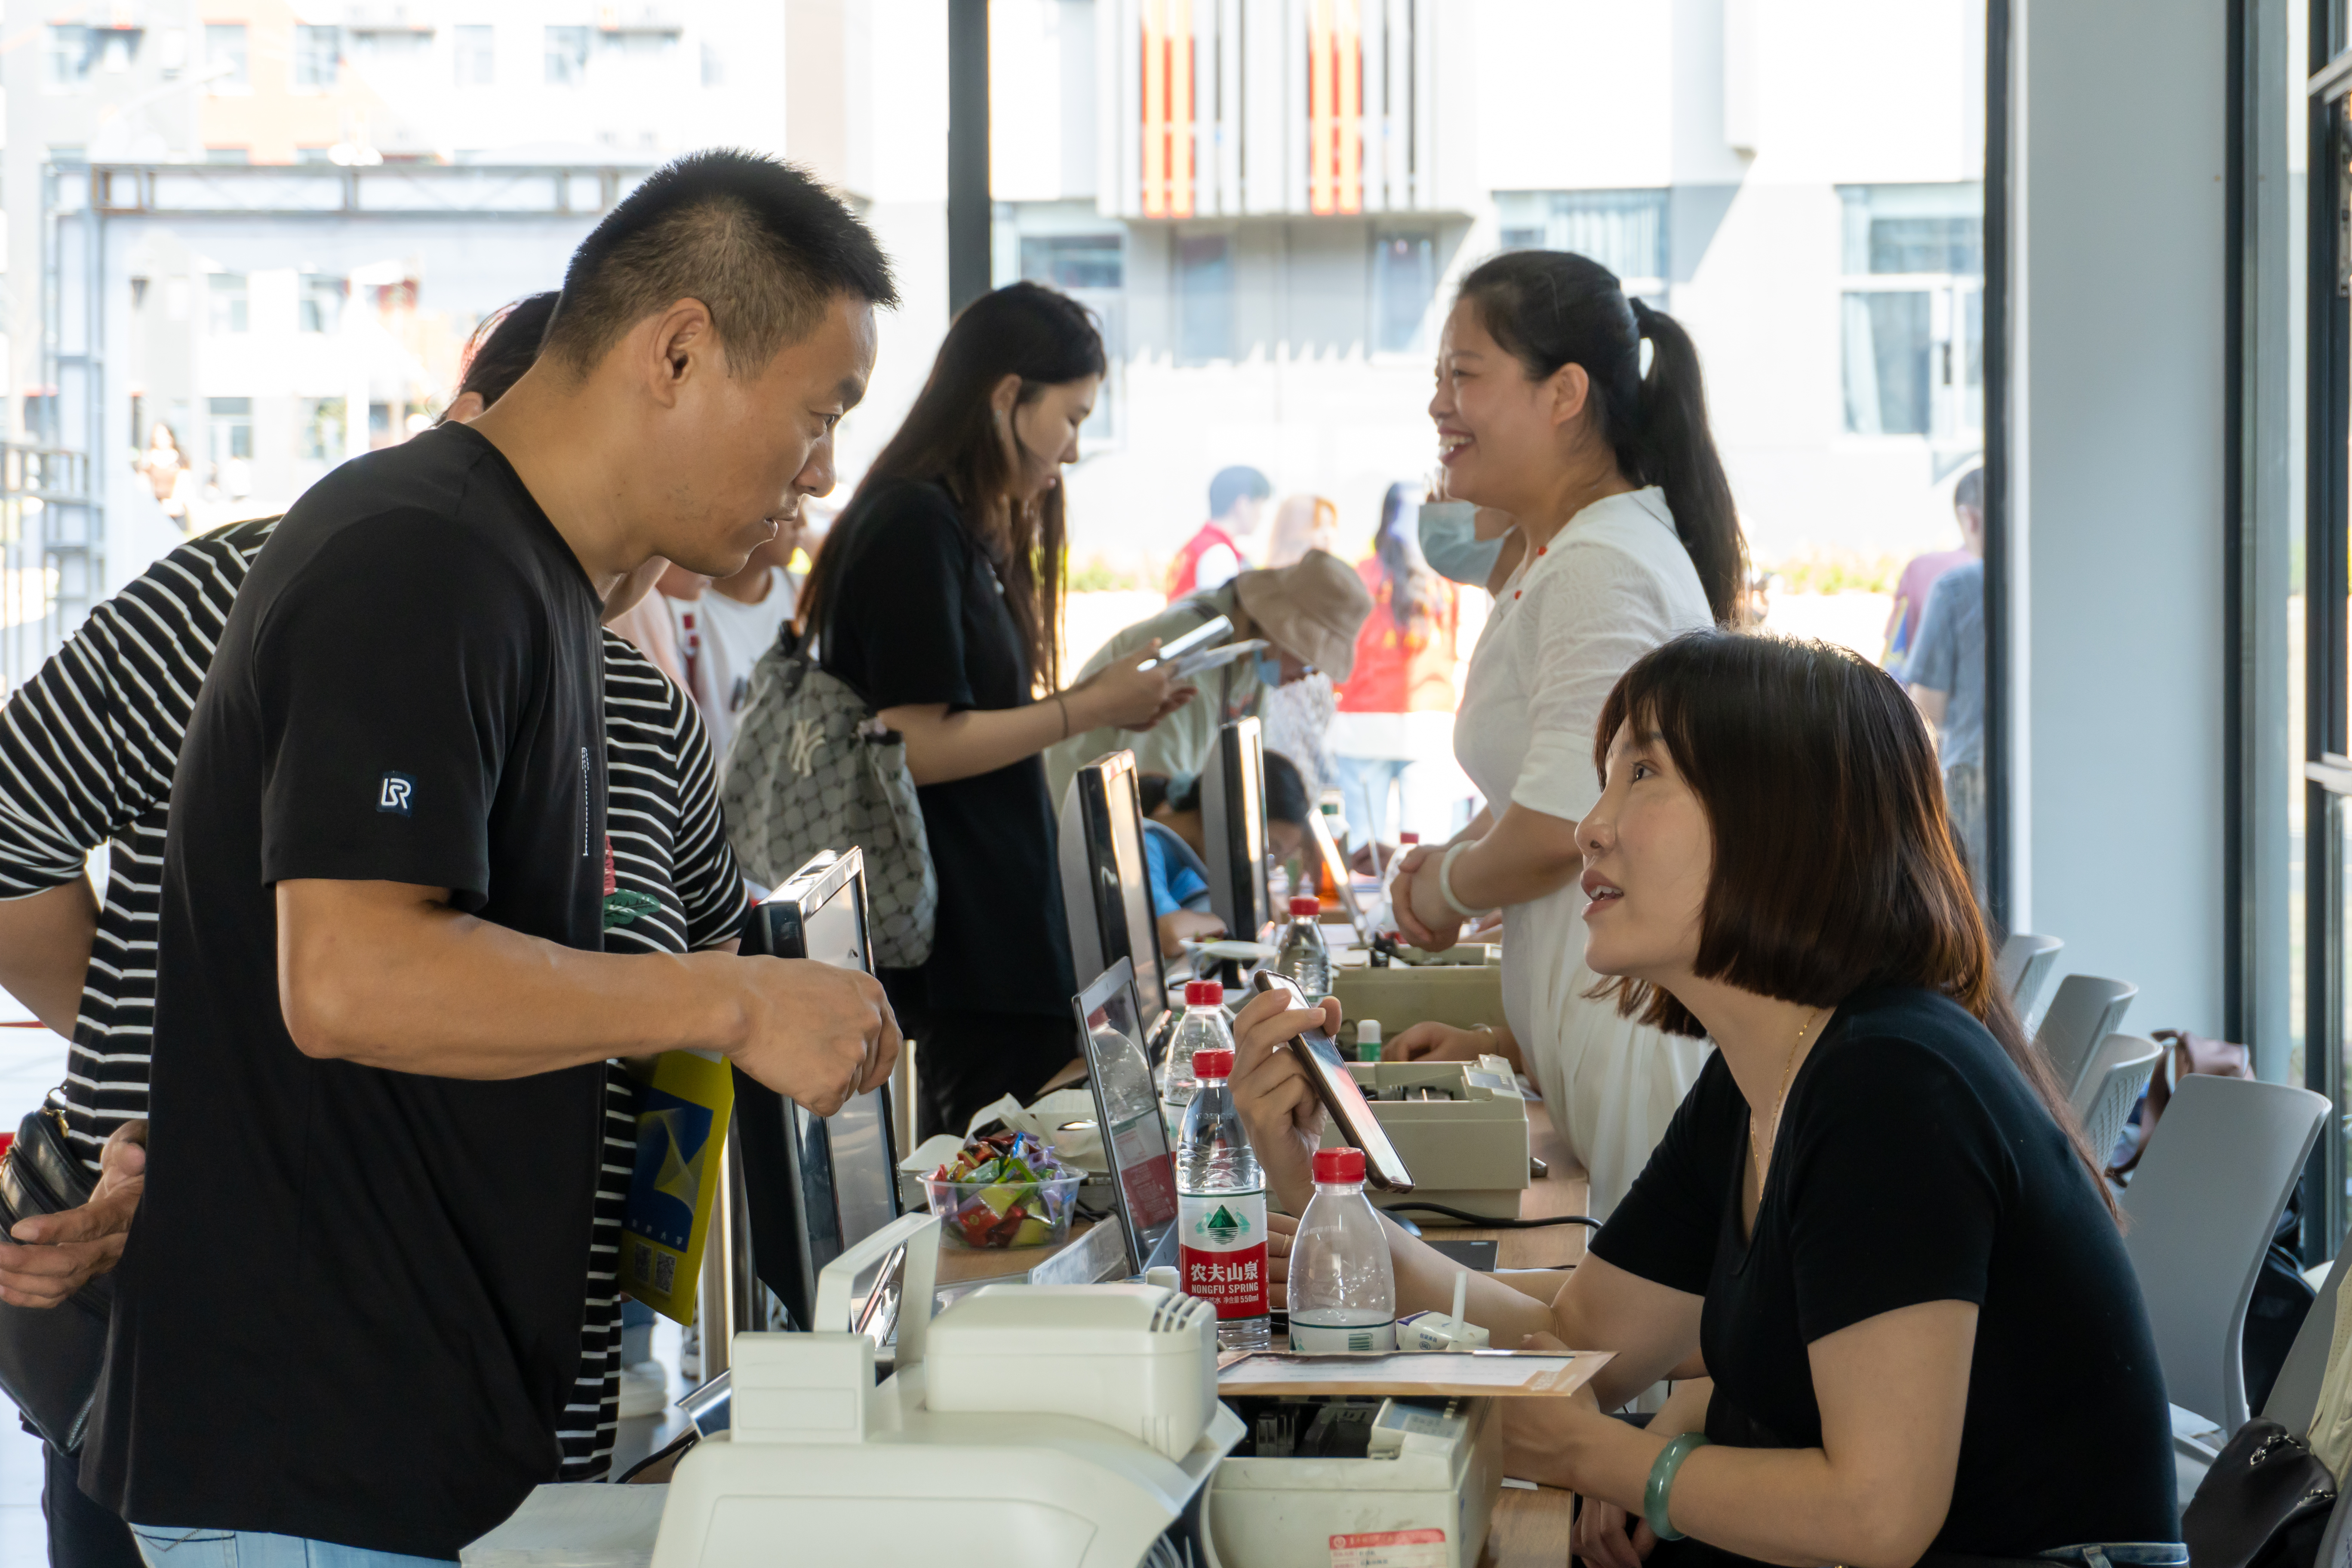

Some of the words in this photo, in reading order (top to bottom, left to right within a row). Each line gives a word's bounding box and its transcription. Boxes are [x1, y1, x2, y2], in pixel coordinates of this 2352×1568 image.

[1190, 1261, 1258, 1282] 农夫山泉
[1192, 1284, 1225, 1294] NONGFU
[1228, 1282, 1258, 1294] SPRING
